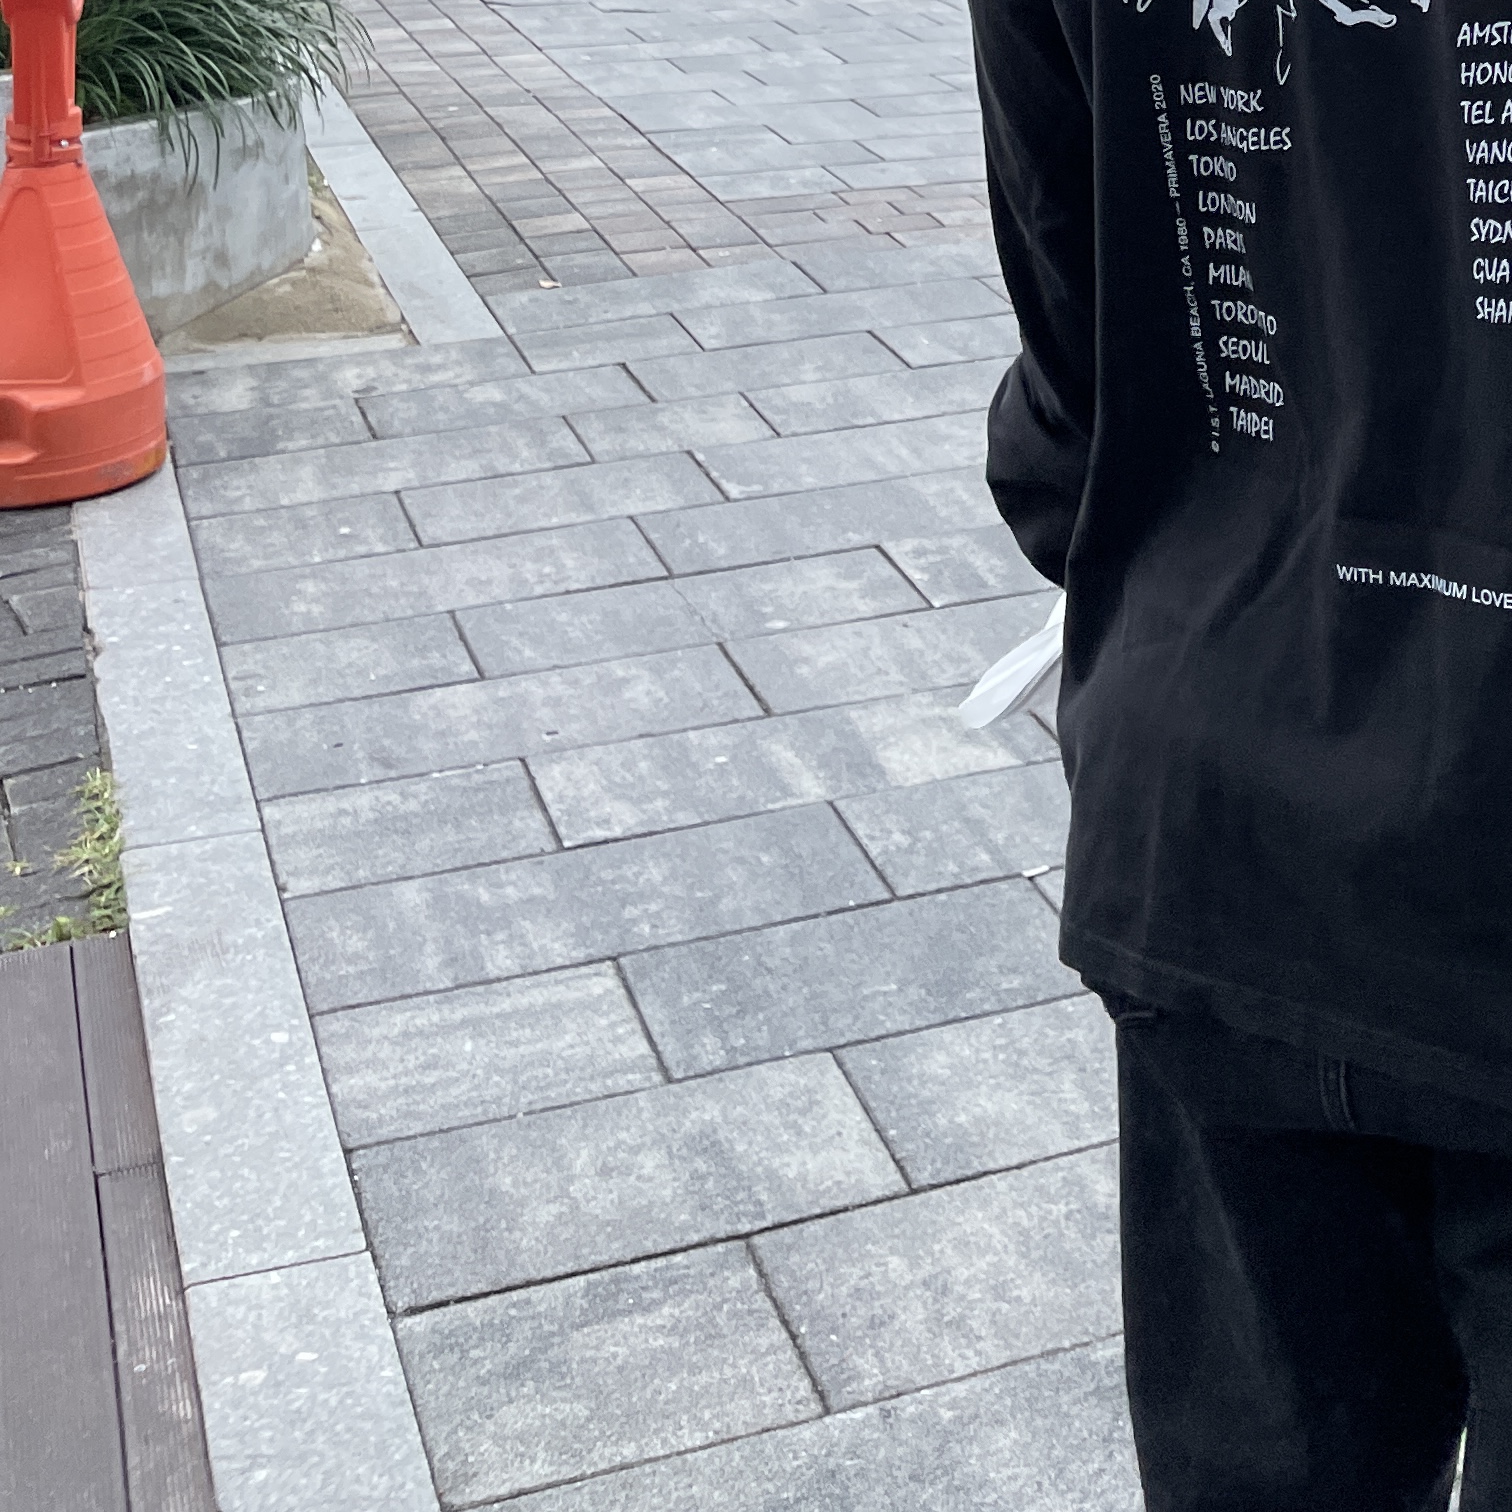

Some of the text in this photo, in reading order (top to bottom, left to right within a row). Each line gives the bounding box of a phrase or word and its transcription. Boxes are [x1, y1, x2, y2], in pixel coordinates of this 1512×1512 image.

[1150, 74, 1167, 110] 2020
[1179, 81, 1265, 114] NEW YORK
[1459, 100, 1495, 125] TEL
[1186, 117, 1292, 154] LOS ANGELES
[1157, 112, 1181, 199] PRIMAVERA
[1198, 190, 1256, 224] LONDON
[1176, 218, 1189, 251] 1980
[1218, 335, 1271, 365] SEOUL
[1225, 370, 1285, 407] MADRID
[1229, 406, 1274, 442] TAIPEI
[1336, 563, 1383, 585] WITH
[1389, 570, 1468, 600] MAXIMUM
